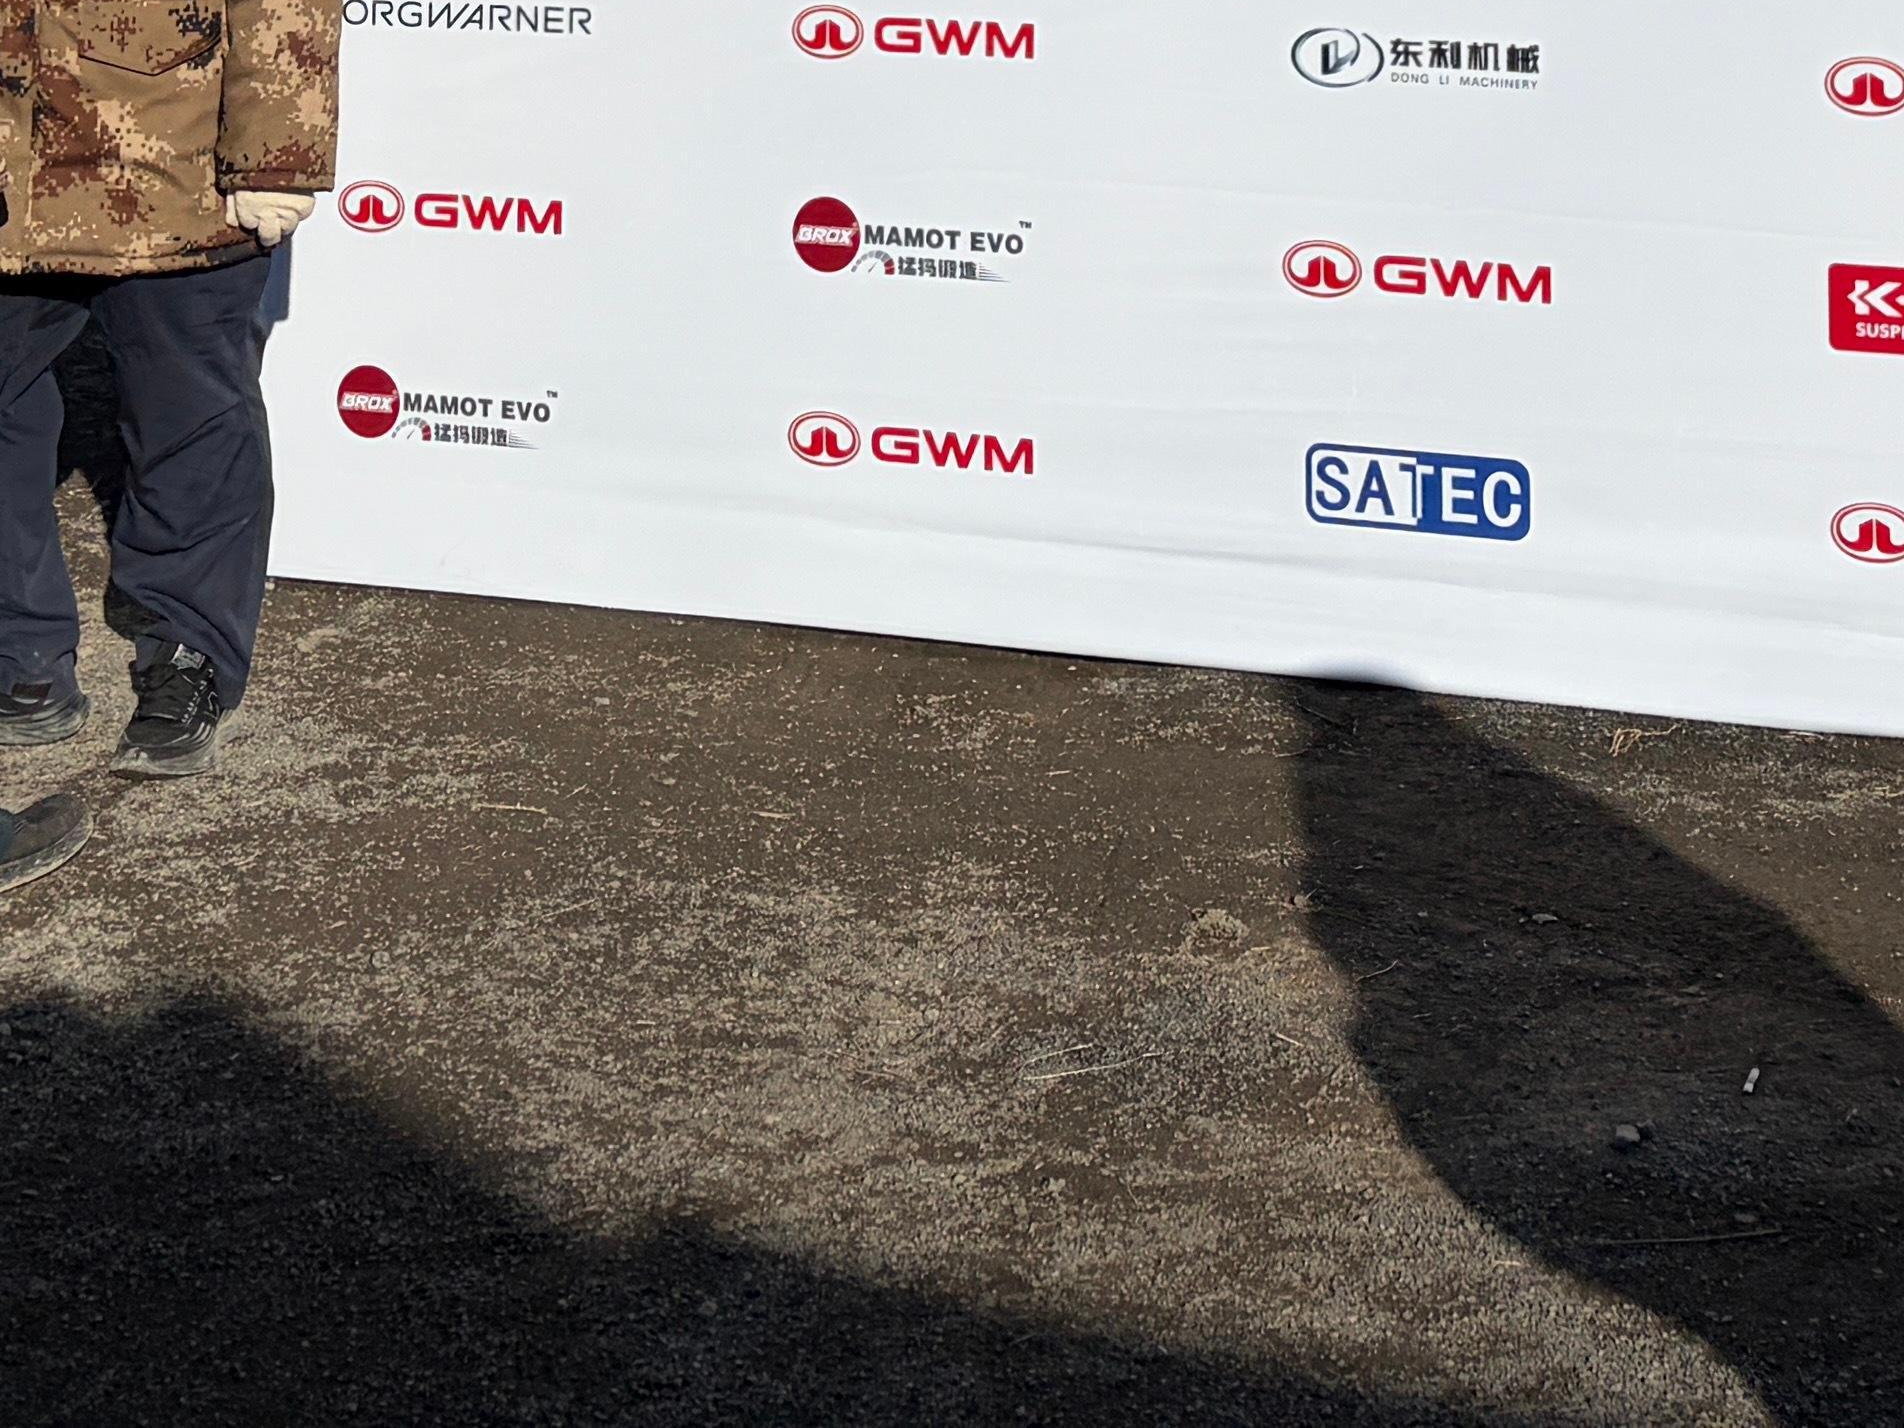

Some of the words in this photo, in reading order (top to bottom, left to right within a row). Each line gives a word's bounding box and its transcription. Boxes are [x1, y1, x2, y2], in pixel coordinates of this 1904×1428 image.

[874, 17, 1035, 59] GWM
[1390, 38, 1540, 74] 东利机械
[1390, 71, 1430, 85] DONG
[1438, 75, 1450, 86] LI
[1459, 76, 1538, 90] MACHINERY
[414, 193, 563, 235] GWM
[864, 224, 961, 251] MAMOT
[970, 231, 1024, 255] EVO
[1373, 255, 1552, 305] GWM
[403, 392, 493, 417] MAMOT
[501, 400, 551, 423] EVO
[871, 426, 1034, 475] GWM
[1315, 456, 1522, 528] SATEC
